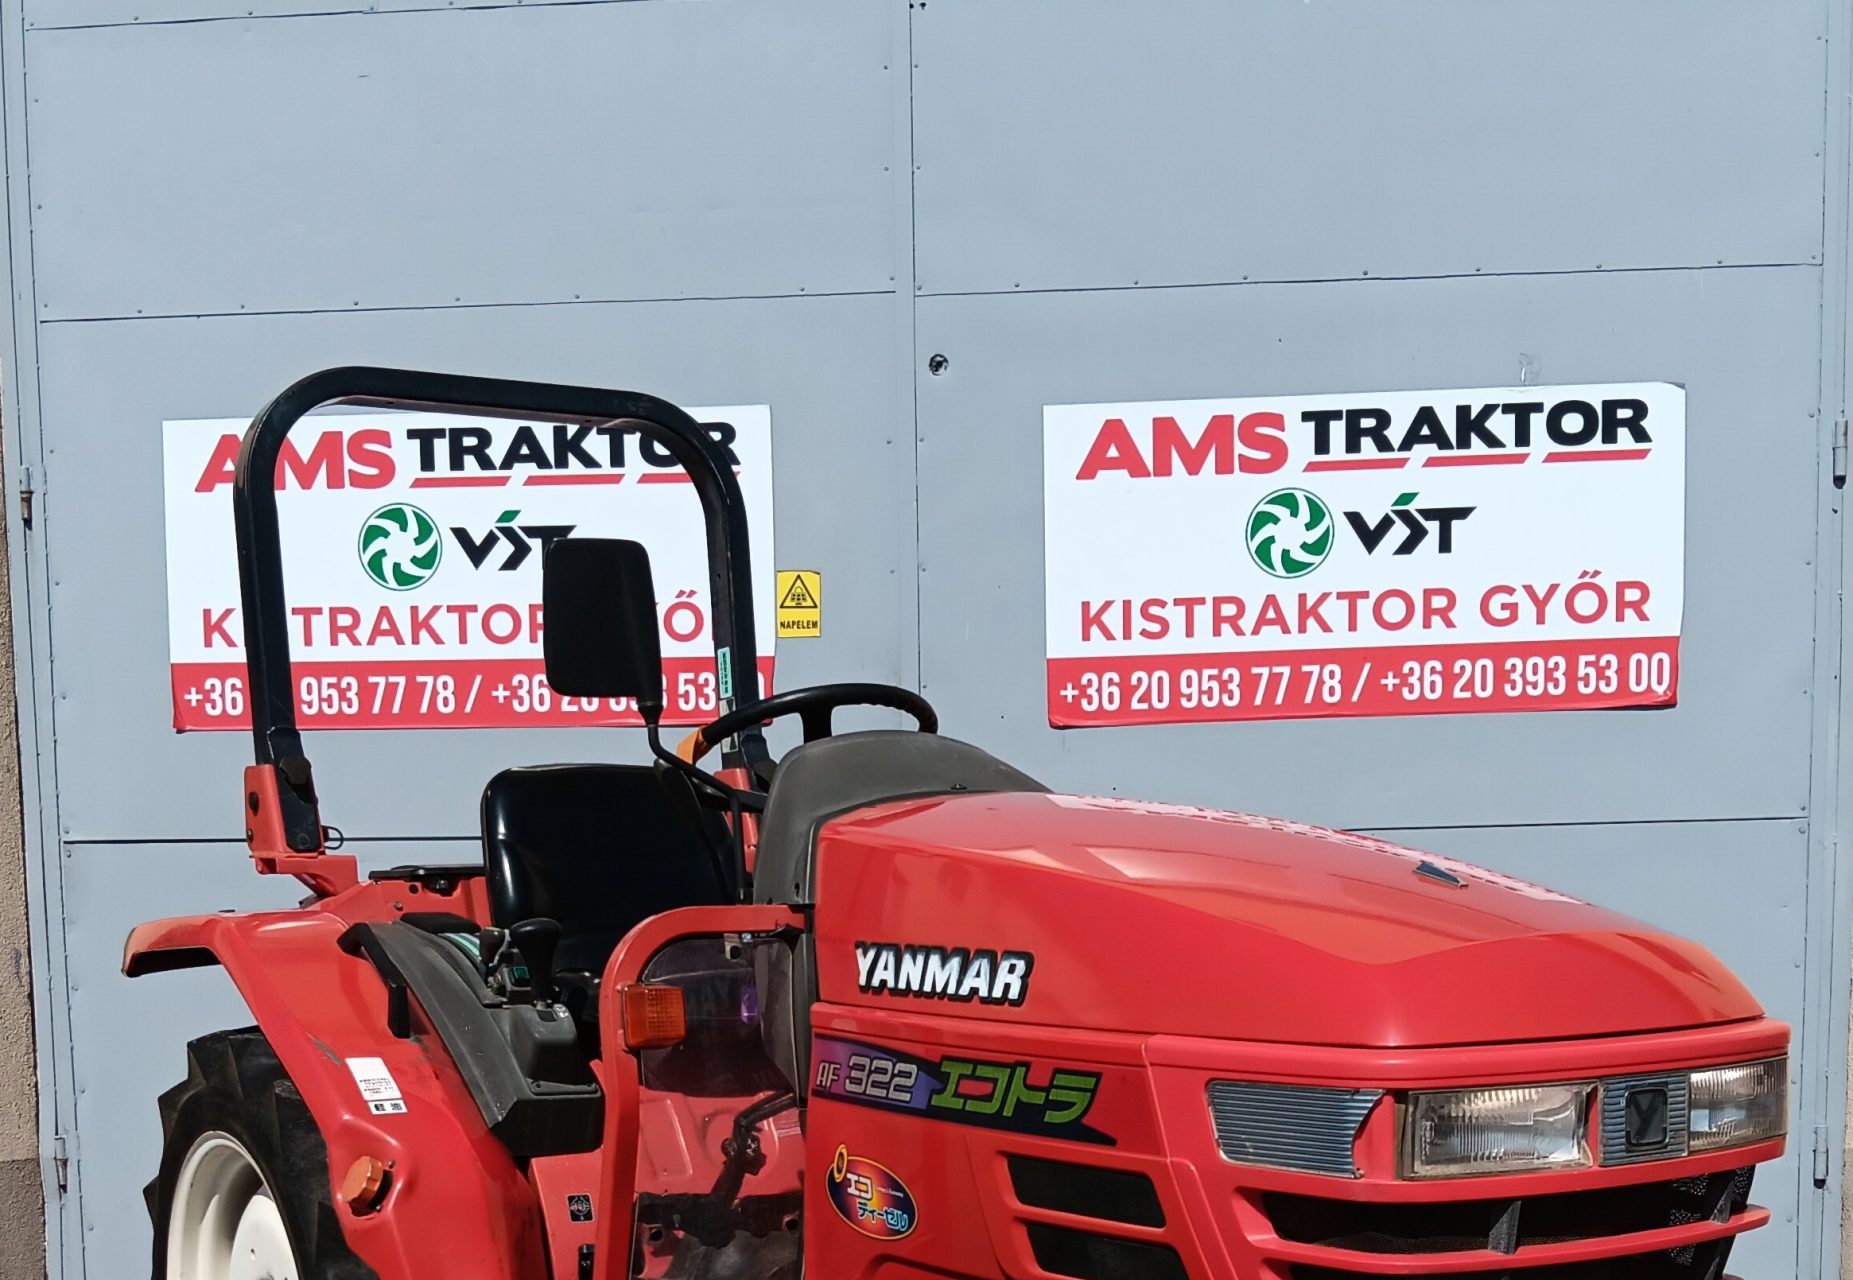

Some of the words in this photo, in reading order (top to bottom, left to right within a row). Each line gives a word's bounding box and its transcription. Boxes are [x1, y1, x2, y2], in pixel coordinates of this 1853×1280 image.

[195, 429, 396, 492] AMS
[1075, 411, 1290, 480] AMS
[1300, 398, 1654, 456] TRAKTOR
[1342, 491, 1478, 556] VST
[779, 619, 819, 630] NAPELEM
[1080, 587, 1458, 643] KISTRAKTOR
[1478, 569, 1652, 628] GYŐR
[184, 676, 245, 717] +36
[300, 675, 360, 716] 953
[367, 675, 407, 715] 77
[415, 674, 456, 715] 78
[491, 673, 550, 713] +36
[677, 672, 716, 711] 53
[1059, 671, 1121, 712] +36
[1130, 669, 1171, 711] 20
[1179, 667, 1242, 709] 953
[1250, 665, 1292, 707] 77
[1300, 663, 1343, 705] 78
[1350, 661, 1372, 703] /
[1379, 659, 1444, 702] +36
[1452, 657, 1495, 699] 20
[1503, 655, 1567, 698] 393
[1576, 653, 1619, 695] 53
[1628, 651, 1671, 694] 00
[855, 942, 1034, 1004] YANMAR
[815, 1061, 841, 1089] AF
[844, 1055, 918, 1102] 322
[930, 1059, 1098, 1124] エコトラ
